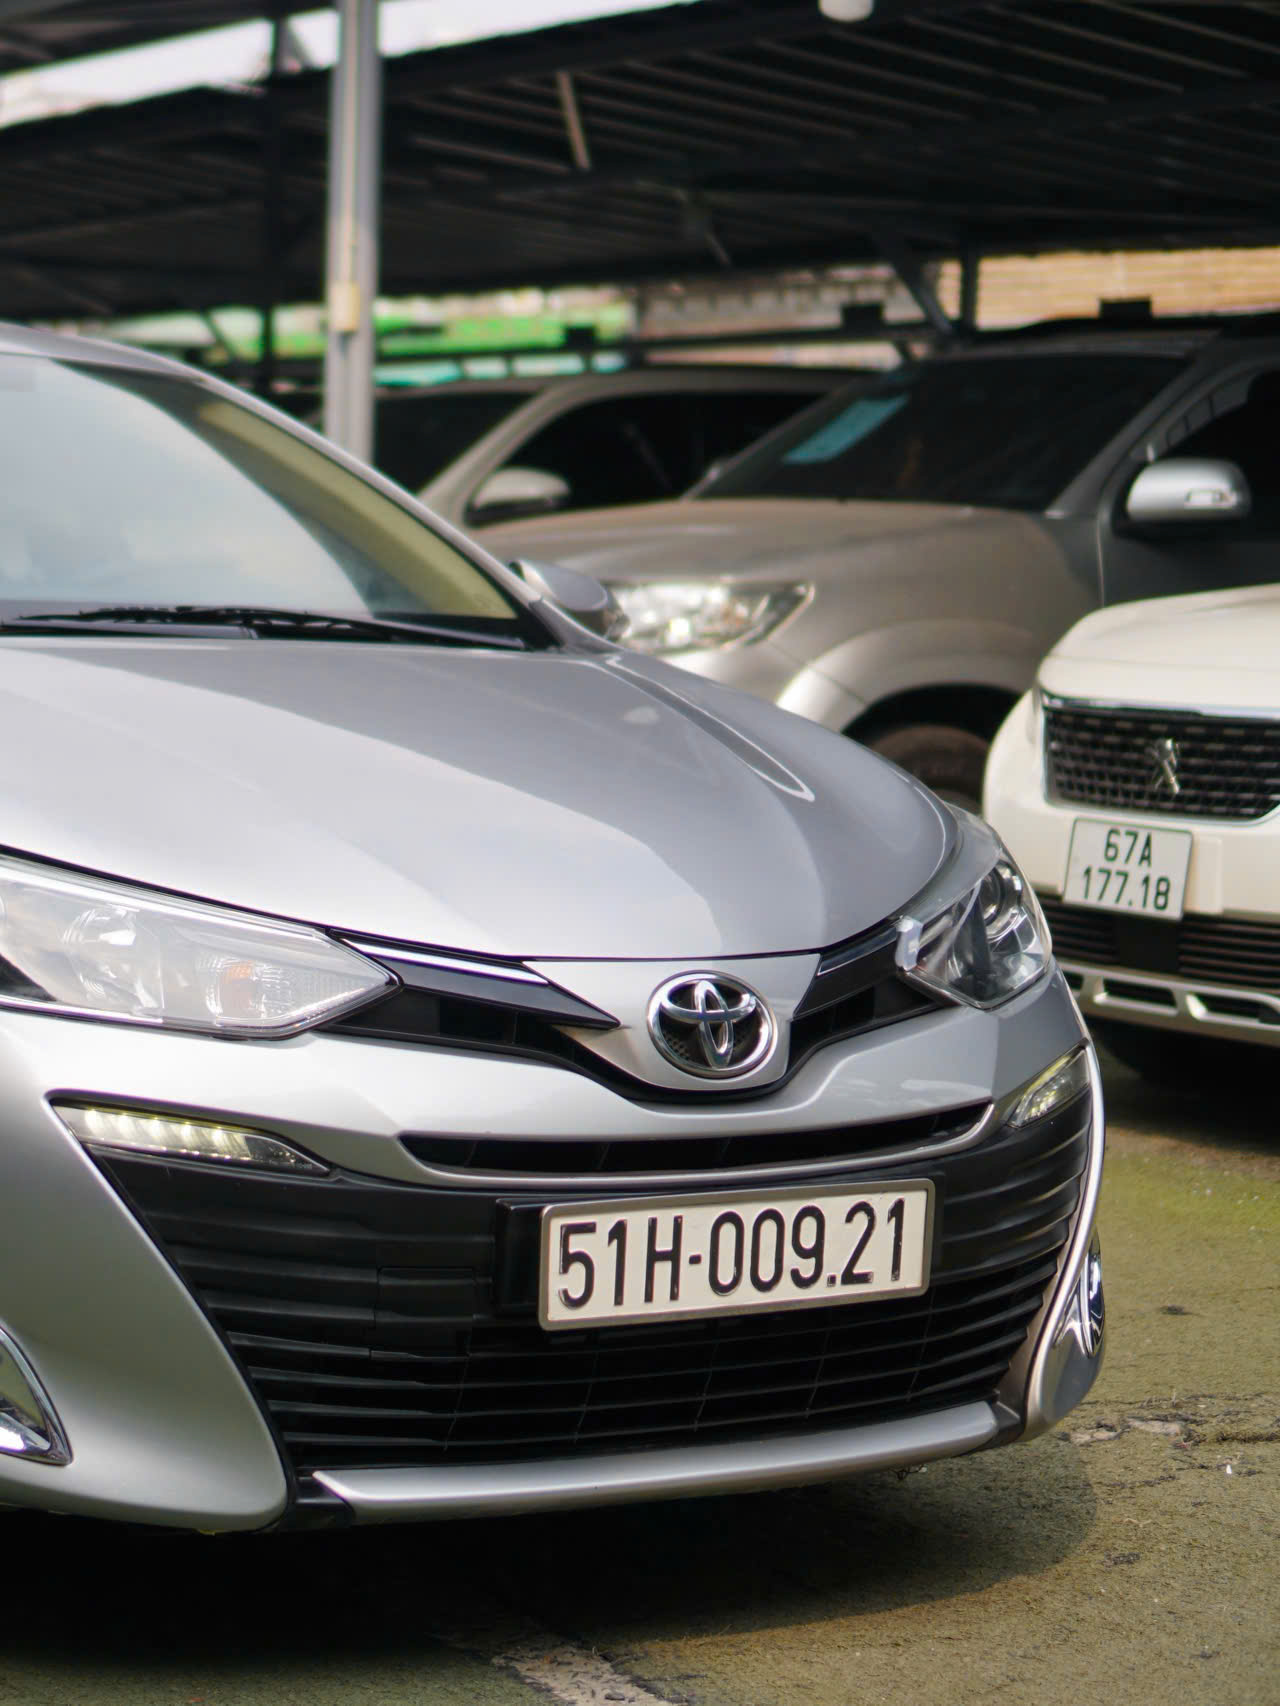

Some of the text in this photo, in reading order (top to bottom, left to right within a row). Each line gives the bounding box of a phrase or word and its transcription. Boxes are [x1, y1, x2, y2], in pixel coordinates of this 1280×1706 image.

[1104, 828, 1152, 868] 67A
[1083, 866, 1171, 911] 177.18
[558, 1198, 905, 1310] 51H-009.21
